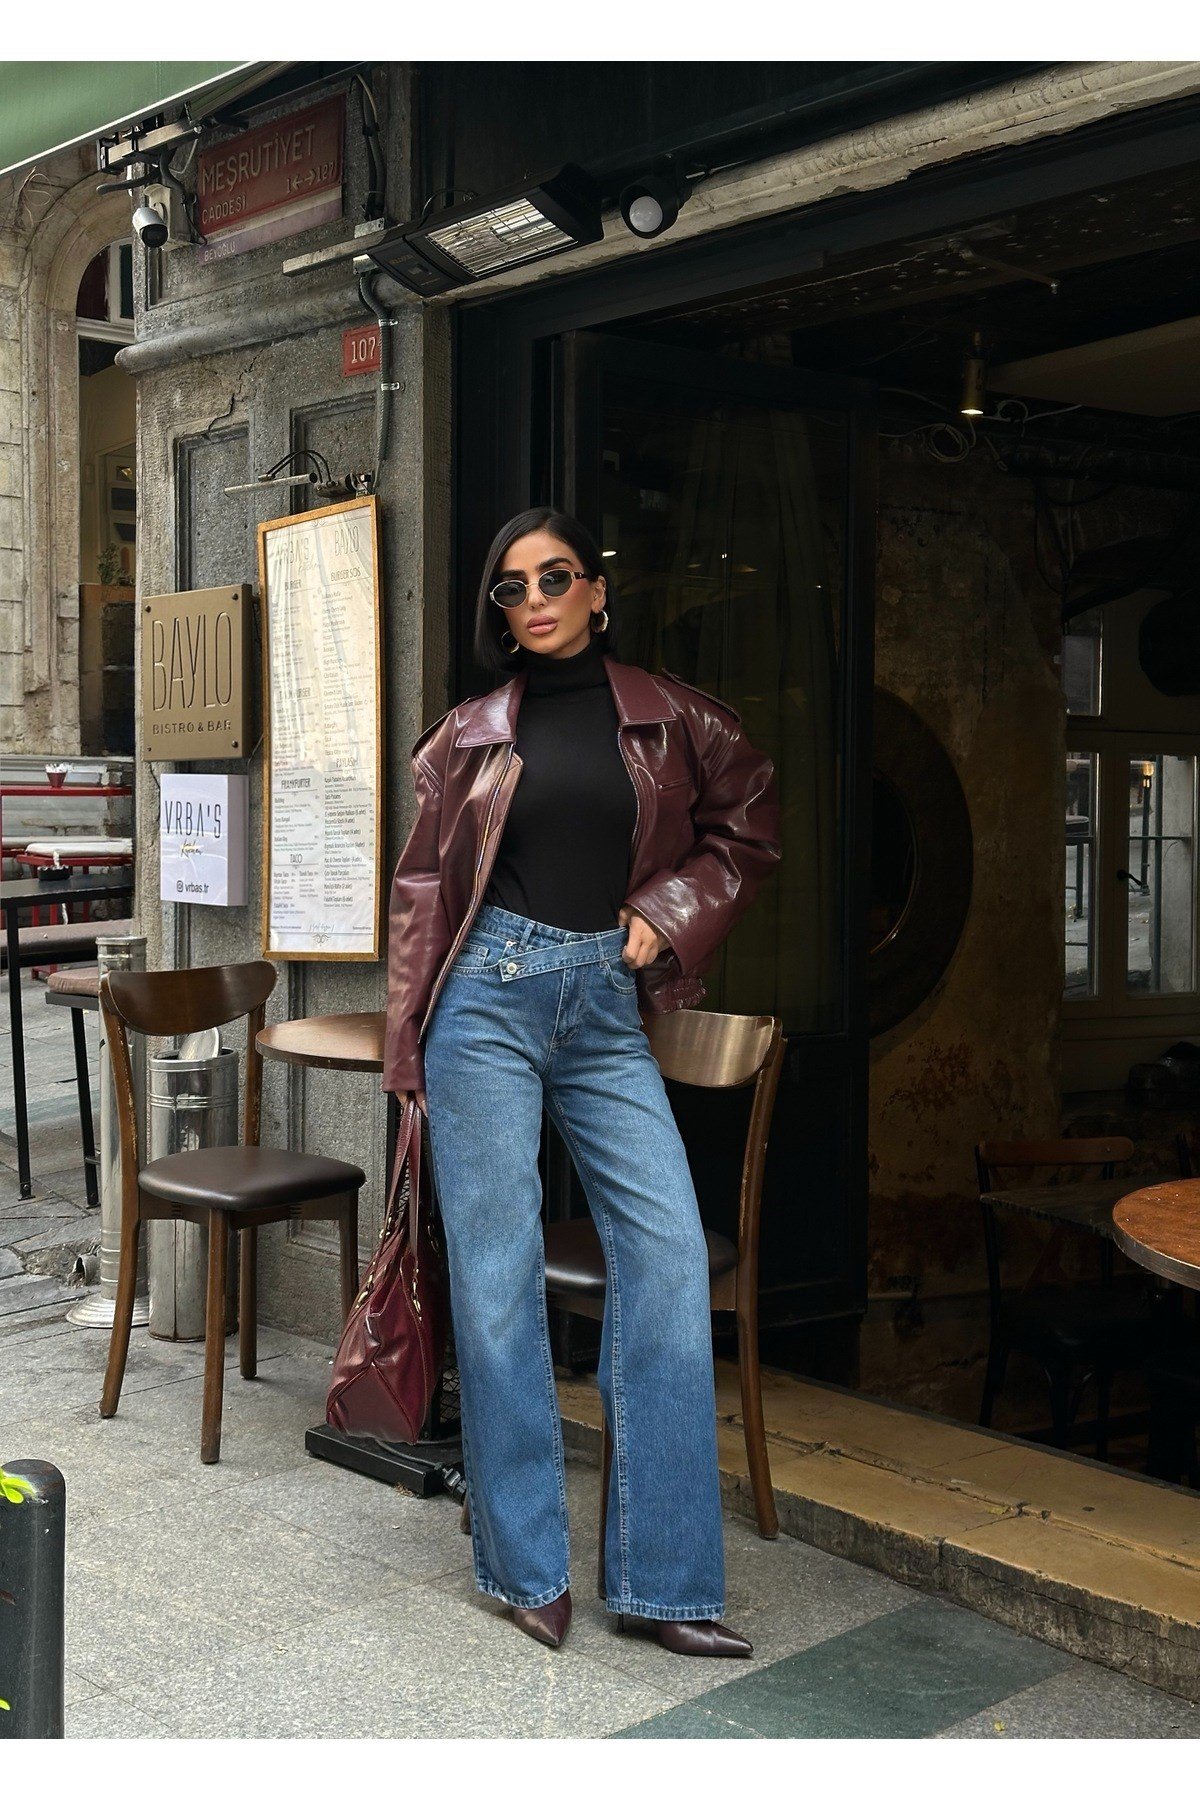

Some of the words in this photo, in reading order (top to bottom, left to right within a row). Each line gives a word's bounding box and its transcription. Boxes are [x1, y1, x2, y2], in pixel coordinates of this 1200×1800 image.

[202, 125, 315, 196] MEŞRUTİYET
[204, 241, 236, 262] BEYOĞLU
[351, 336, 376, 364] 107
[152, 611, 232, 711] BAYLO
[152, 722, 194, 735] BISTRO
[197, 722, 204, 732] &
[207, 719, 232, 732] BAR
[165, 800, 222, 838] VRBA'S
[290, 853, 303, 864] TACO
[185, 881, 209, 894] vrbas.tr
